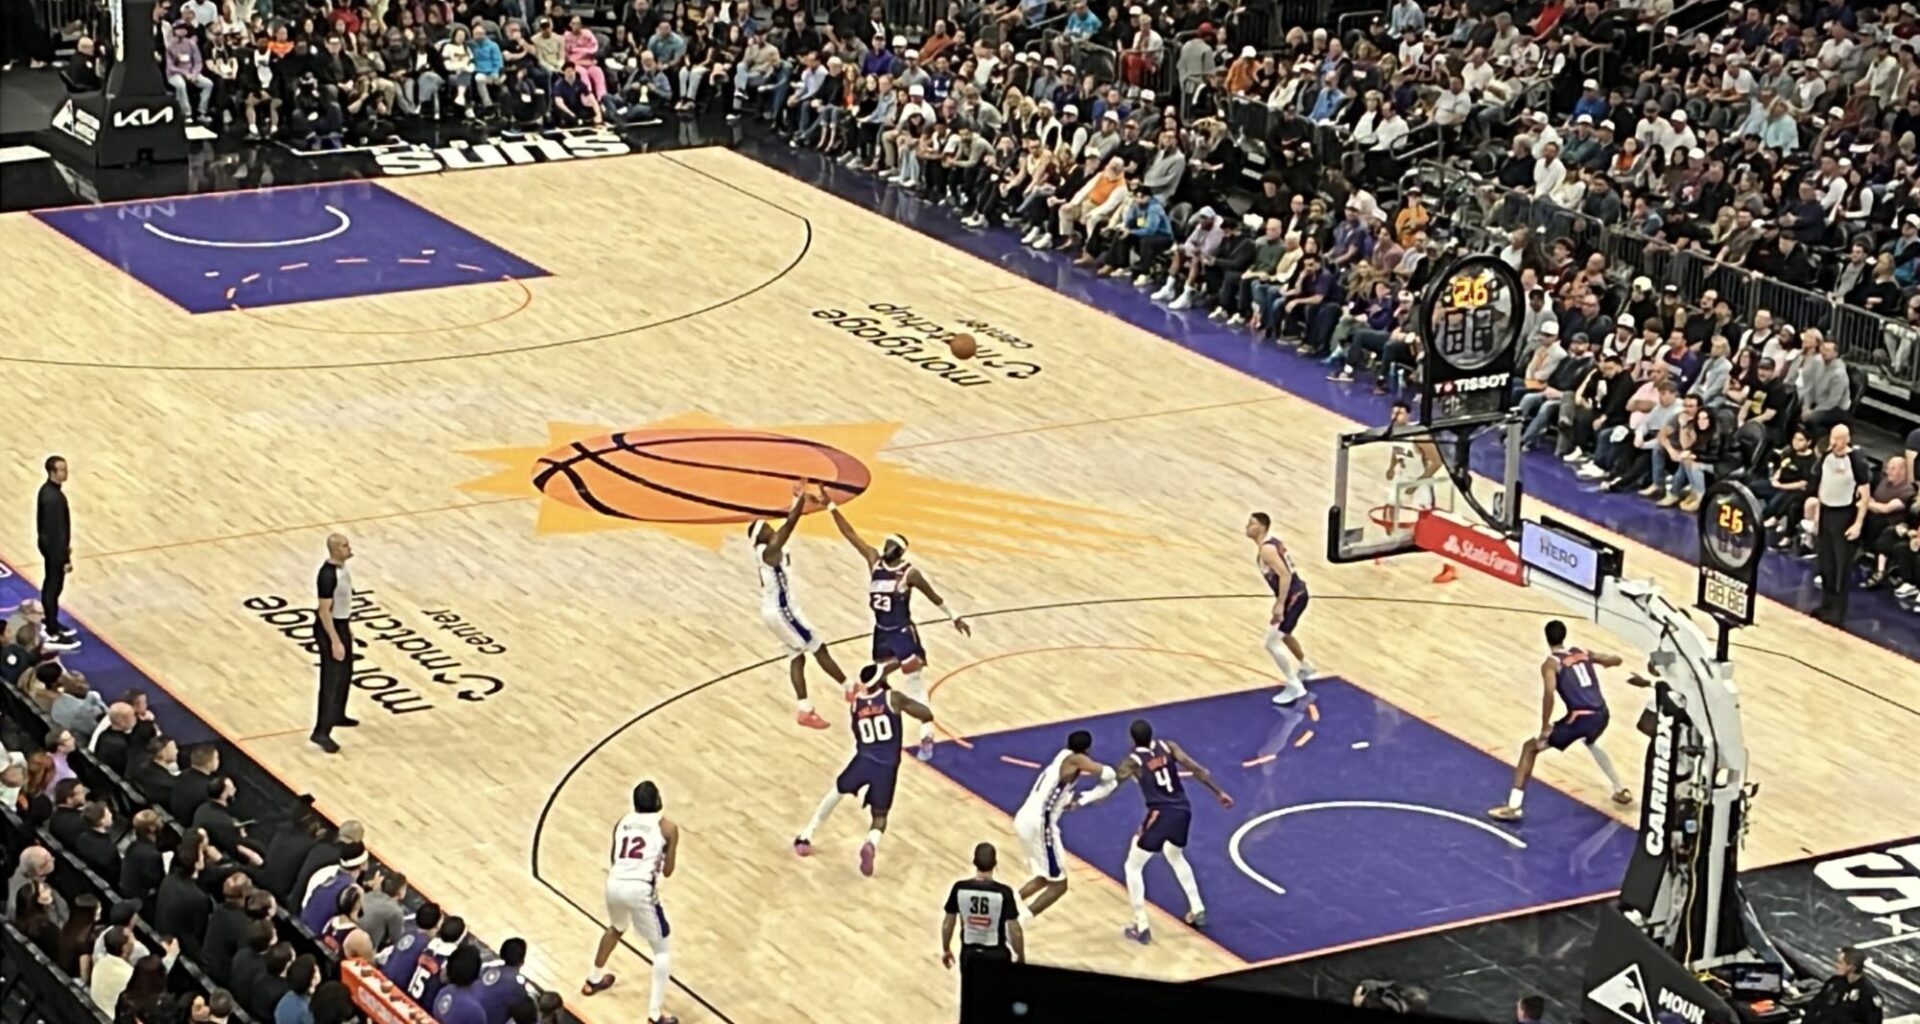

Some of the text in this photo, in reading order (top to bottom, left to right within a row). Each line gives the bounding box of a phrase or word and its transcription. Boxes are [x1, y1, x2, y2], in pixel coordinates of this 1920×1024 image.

[113, 105, 174, 128] KIA
[375, 134, 631, 176] suns
[811, 308, 992, 387] mortgage
[1454, 372, 1510, 393] TISSOT
[1540, 537, 1578, 569] HERO
[873, 593, 892, 613] 23
[421, 608, 507, 655] center
[1572, 661, 1593, 688] 11
[857, 714, 894, 744] 00
[1154, 767, 1174, 793] 4
[618, 836, 647, 860] 12
[969, 895, 990, 916] 36
[407, 964, 432, 1000] 15
